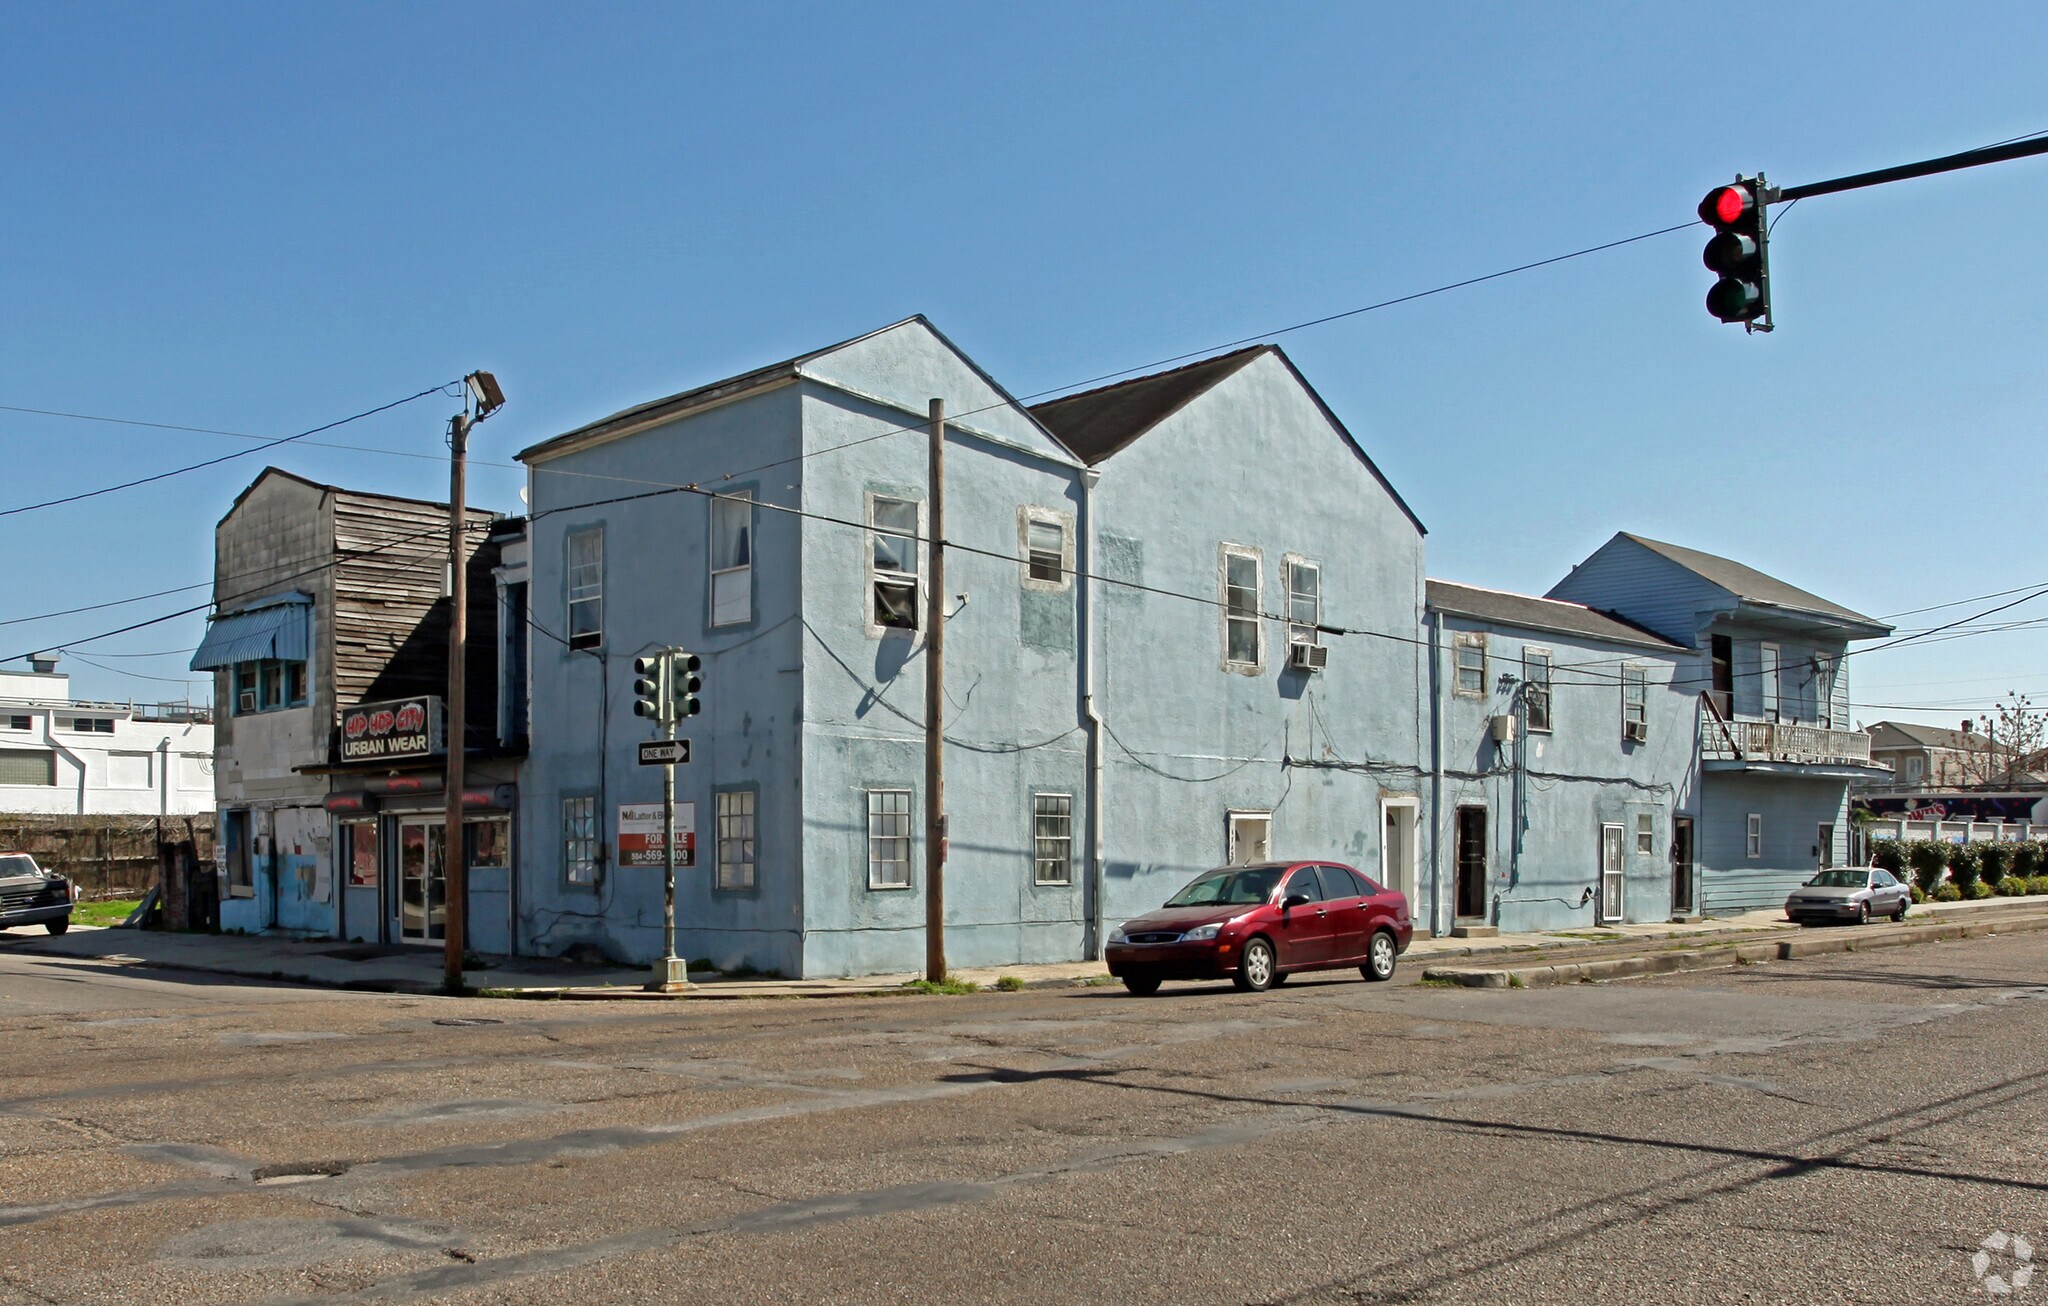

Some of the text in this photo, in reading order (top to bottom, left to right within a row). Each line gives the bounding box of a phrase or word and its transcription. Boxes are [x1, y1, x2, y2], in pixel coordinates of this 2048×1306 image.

[346, 704, 425, 739] HIP HOP CITY
[345, 734, 427, 756] URBAN WEAR
[643, 747, 674, 759] ONE WAY
[634, 811, 651, 821] Latter
[651, 811, 657, 820] &
[645, 833, 663, 844] FOR
